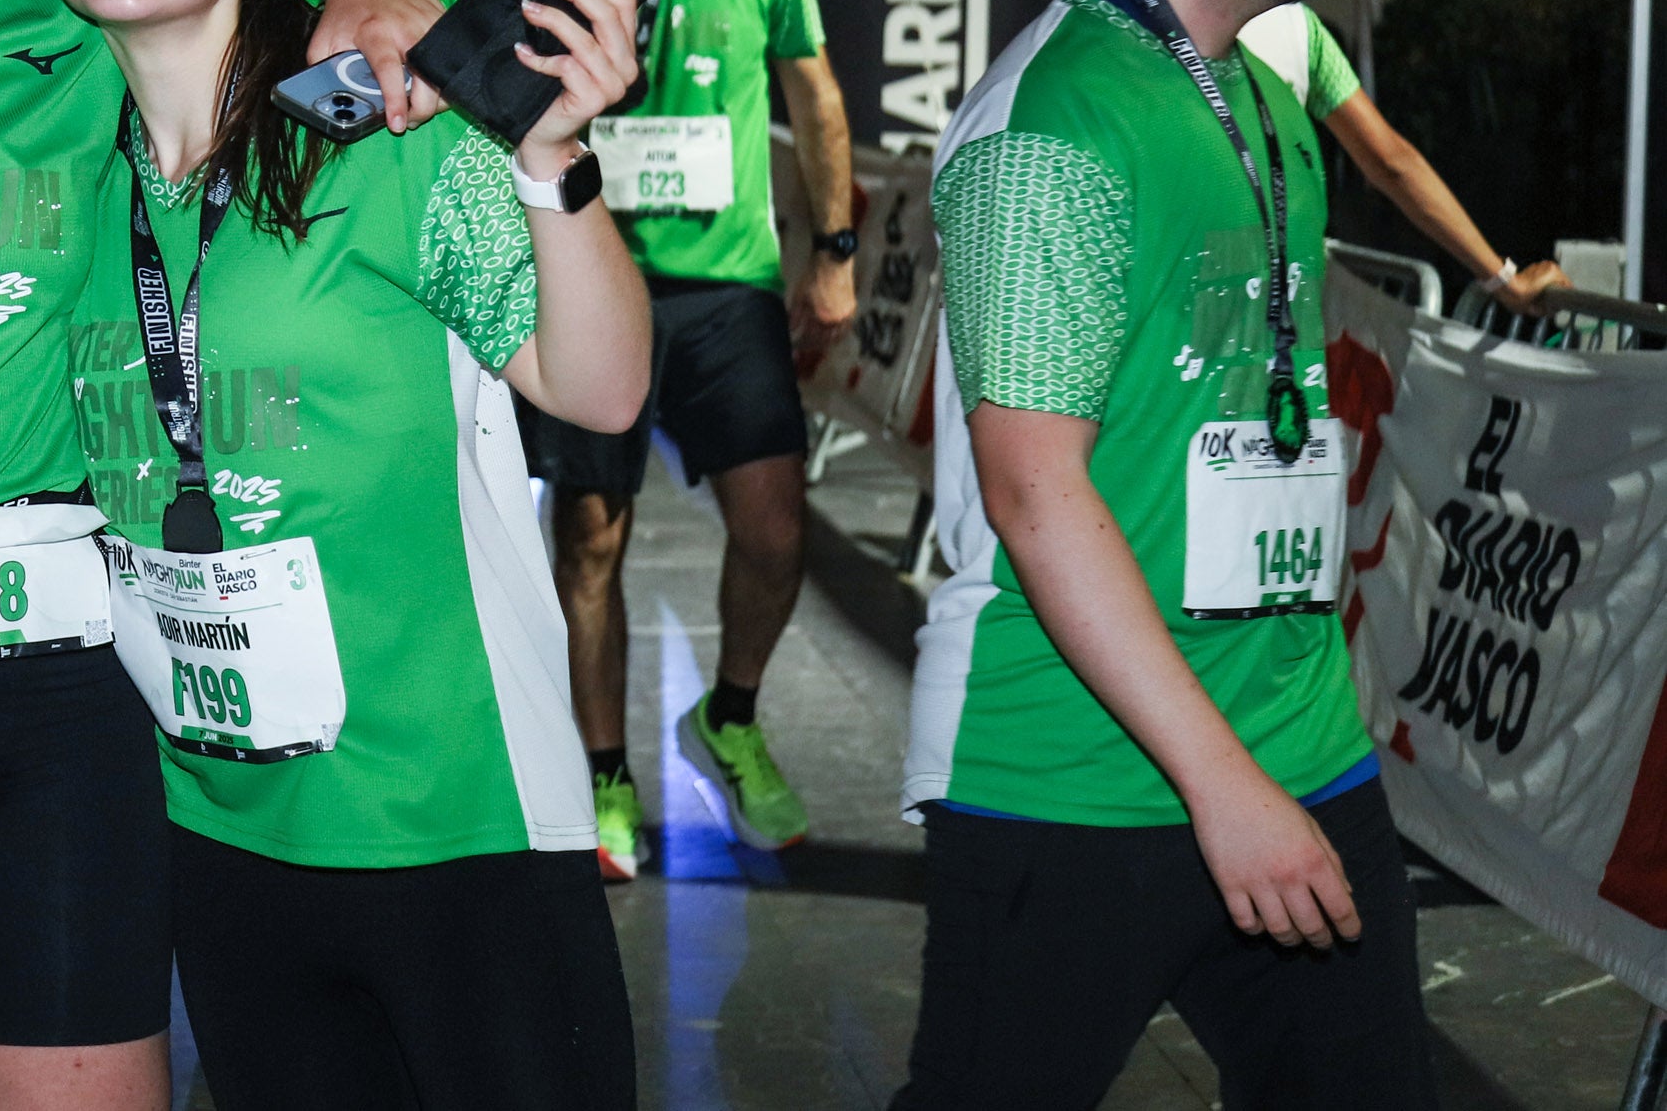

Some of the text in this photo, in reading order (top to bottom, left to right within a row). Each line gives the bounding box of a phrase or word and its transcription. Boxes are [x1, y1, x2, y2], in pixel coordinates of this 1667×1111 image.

[638, 170, 685, 198] 623
[137, 266, 175, 355] FINISHER
[1200, 427, 1237, 462] 10K
[1465, 395, 1522, 497] EL
[94, 466, 183, 526] ERIES
[212, 469, 282, 506] 2025
[178, 558, 202, 568] Binter
[212, 562, 227, 573] EL
[286, 558, 307, 591] 3
[1254, 527, 1323, 586] 1464
[1434, 498, 1582, 633] DIARIO
[214, 568, 256, 584] DIARIO
[217, 580, 258, 595] VASCO
[183, 616, 251, 651] MARTÍN
[172, 656, 252, 728] F199
[1397, 606, 1541, 756] VASCO
